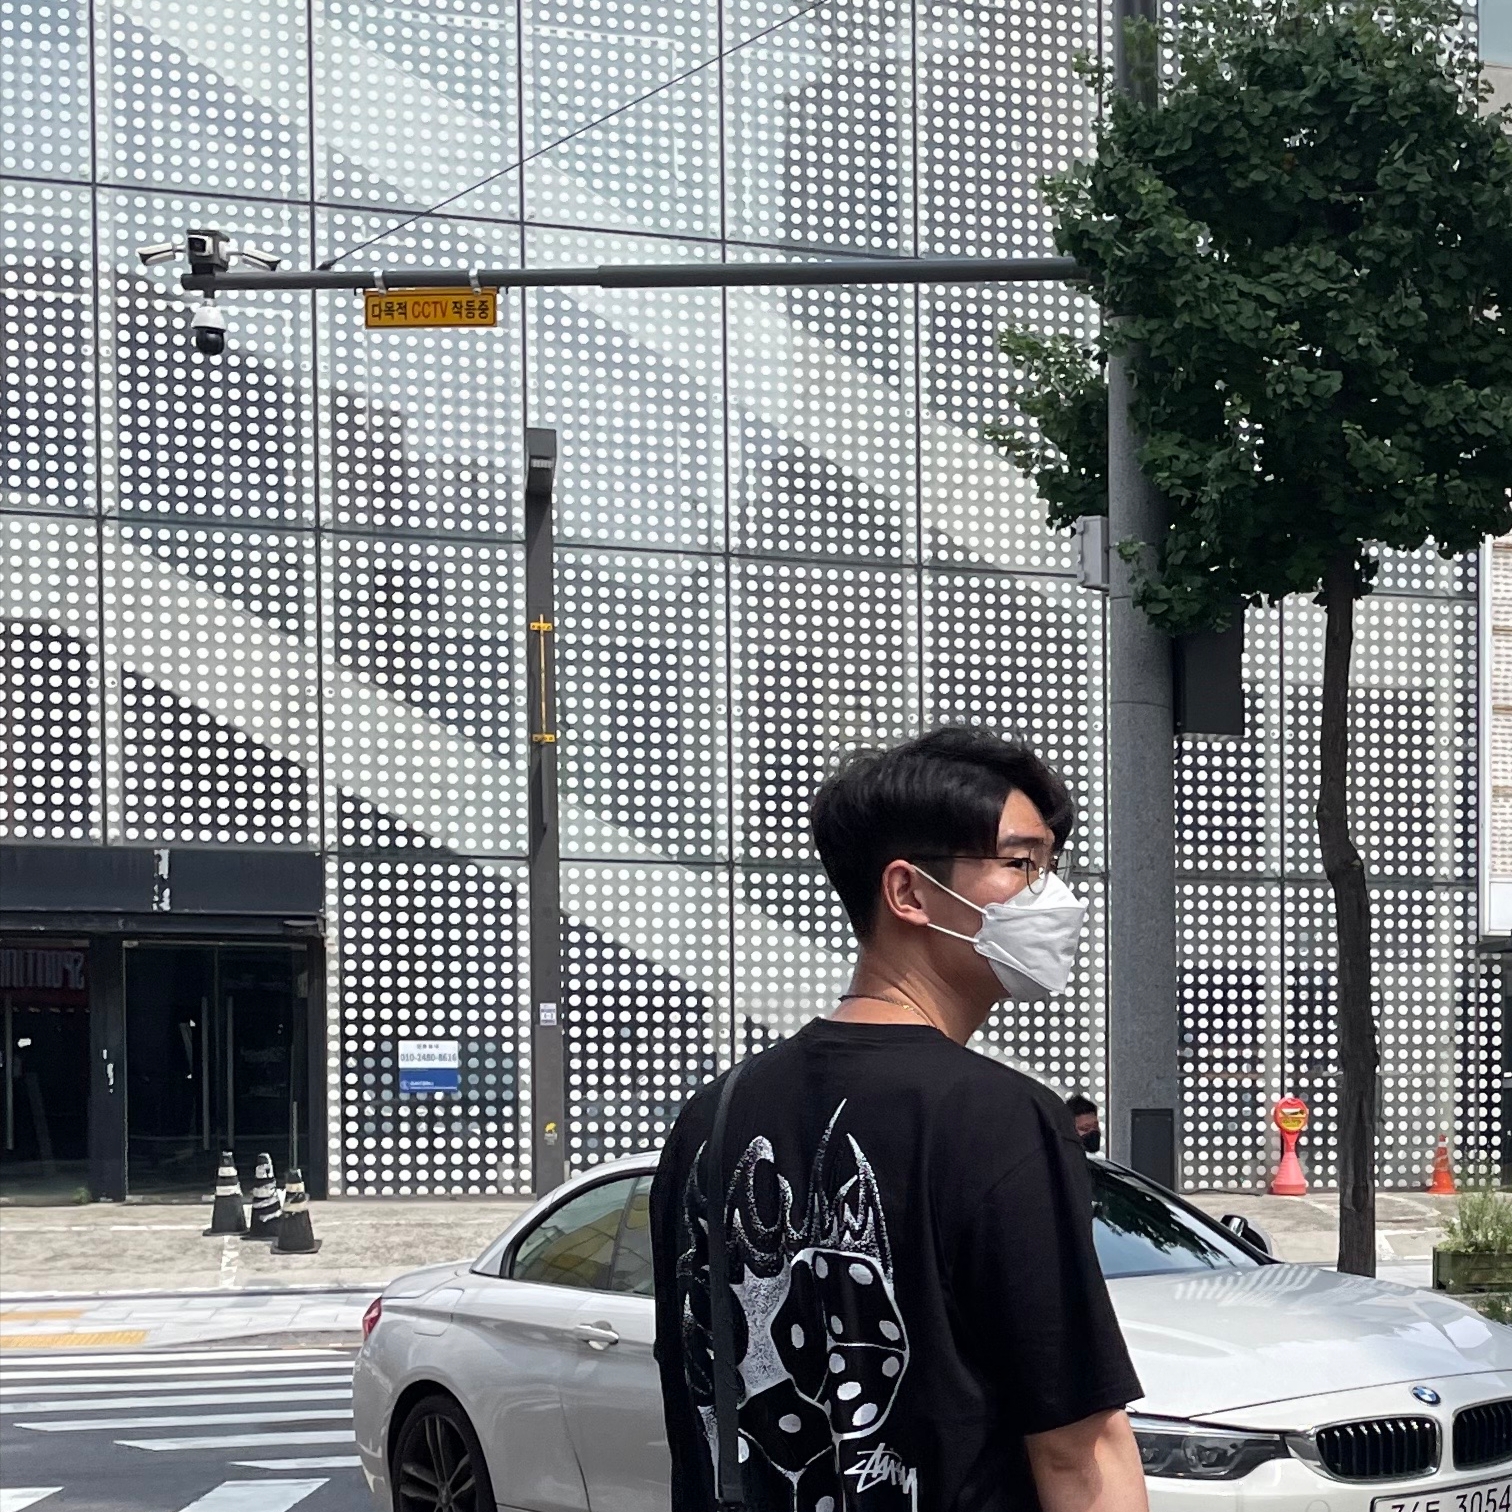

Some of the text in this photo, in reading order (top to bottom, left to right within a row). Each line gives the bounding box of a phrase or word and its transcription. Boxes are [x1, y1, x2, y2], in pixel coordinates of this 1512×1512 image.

[371, 300, 489, 320] 다목적 CCTV 작동중
